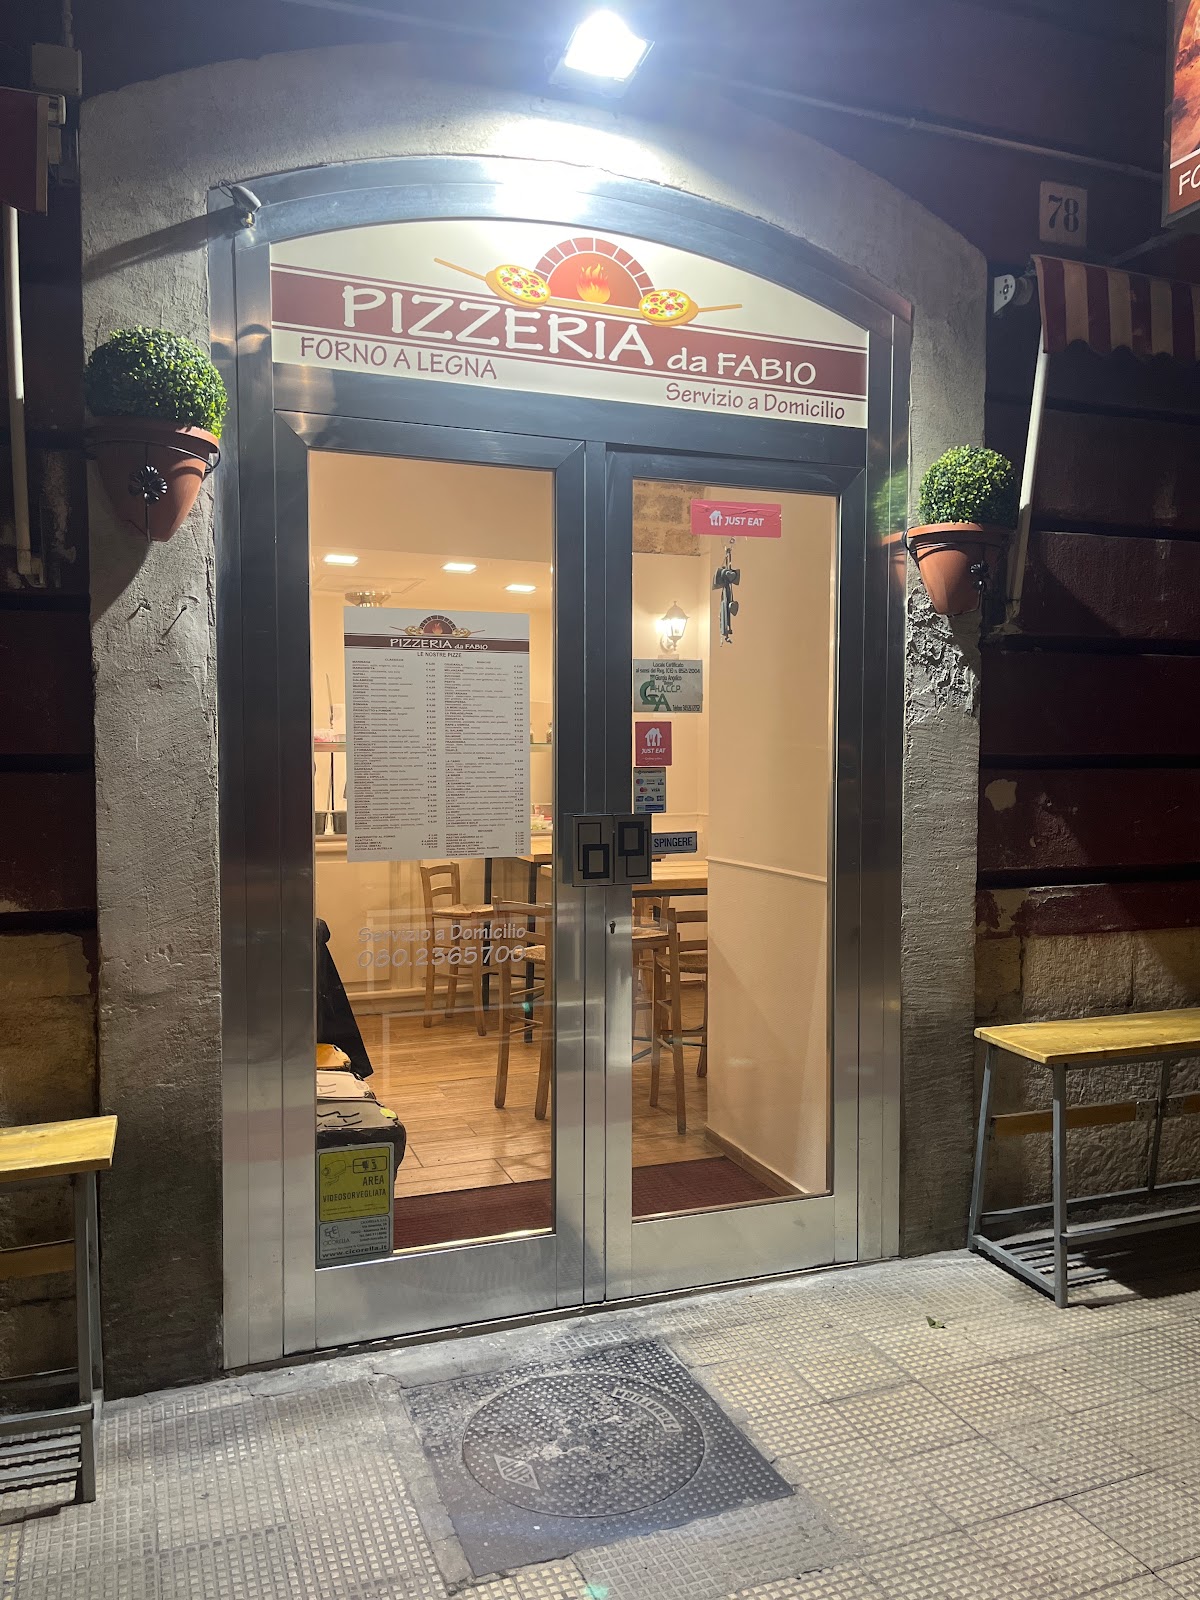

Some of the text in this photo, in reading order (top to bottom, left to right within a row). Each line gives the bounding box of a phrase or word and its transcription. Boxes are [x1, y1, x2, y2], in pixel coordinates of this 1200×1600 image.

[1048, 194, 1080, 233] 78
[342, 285, 817, 386] PIZZERIA da FABIO
[300, 336, 498, 380] FORNO A LEGNA
[666, 382, 846, 420] Servizio a Domicilio
[724, 516, 764, 527] JUST EAT
[389, 638, 453, 650] PIZZERIA
[465, 643, 489, 651] FABIO
[653, 836, 693, 848] SPINGERE
[358, 922, 527, 943] Servizio a Domicilio
[358, 945, 527, 968] 080.2365700
[362, 1175, 385, 1187] AREA
[322, 1188, 387, 1203] VIDEOSORVEGLIATA
[322, 1244, 388, 1258] www.cicorella.it
